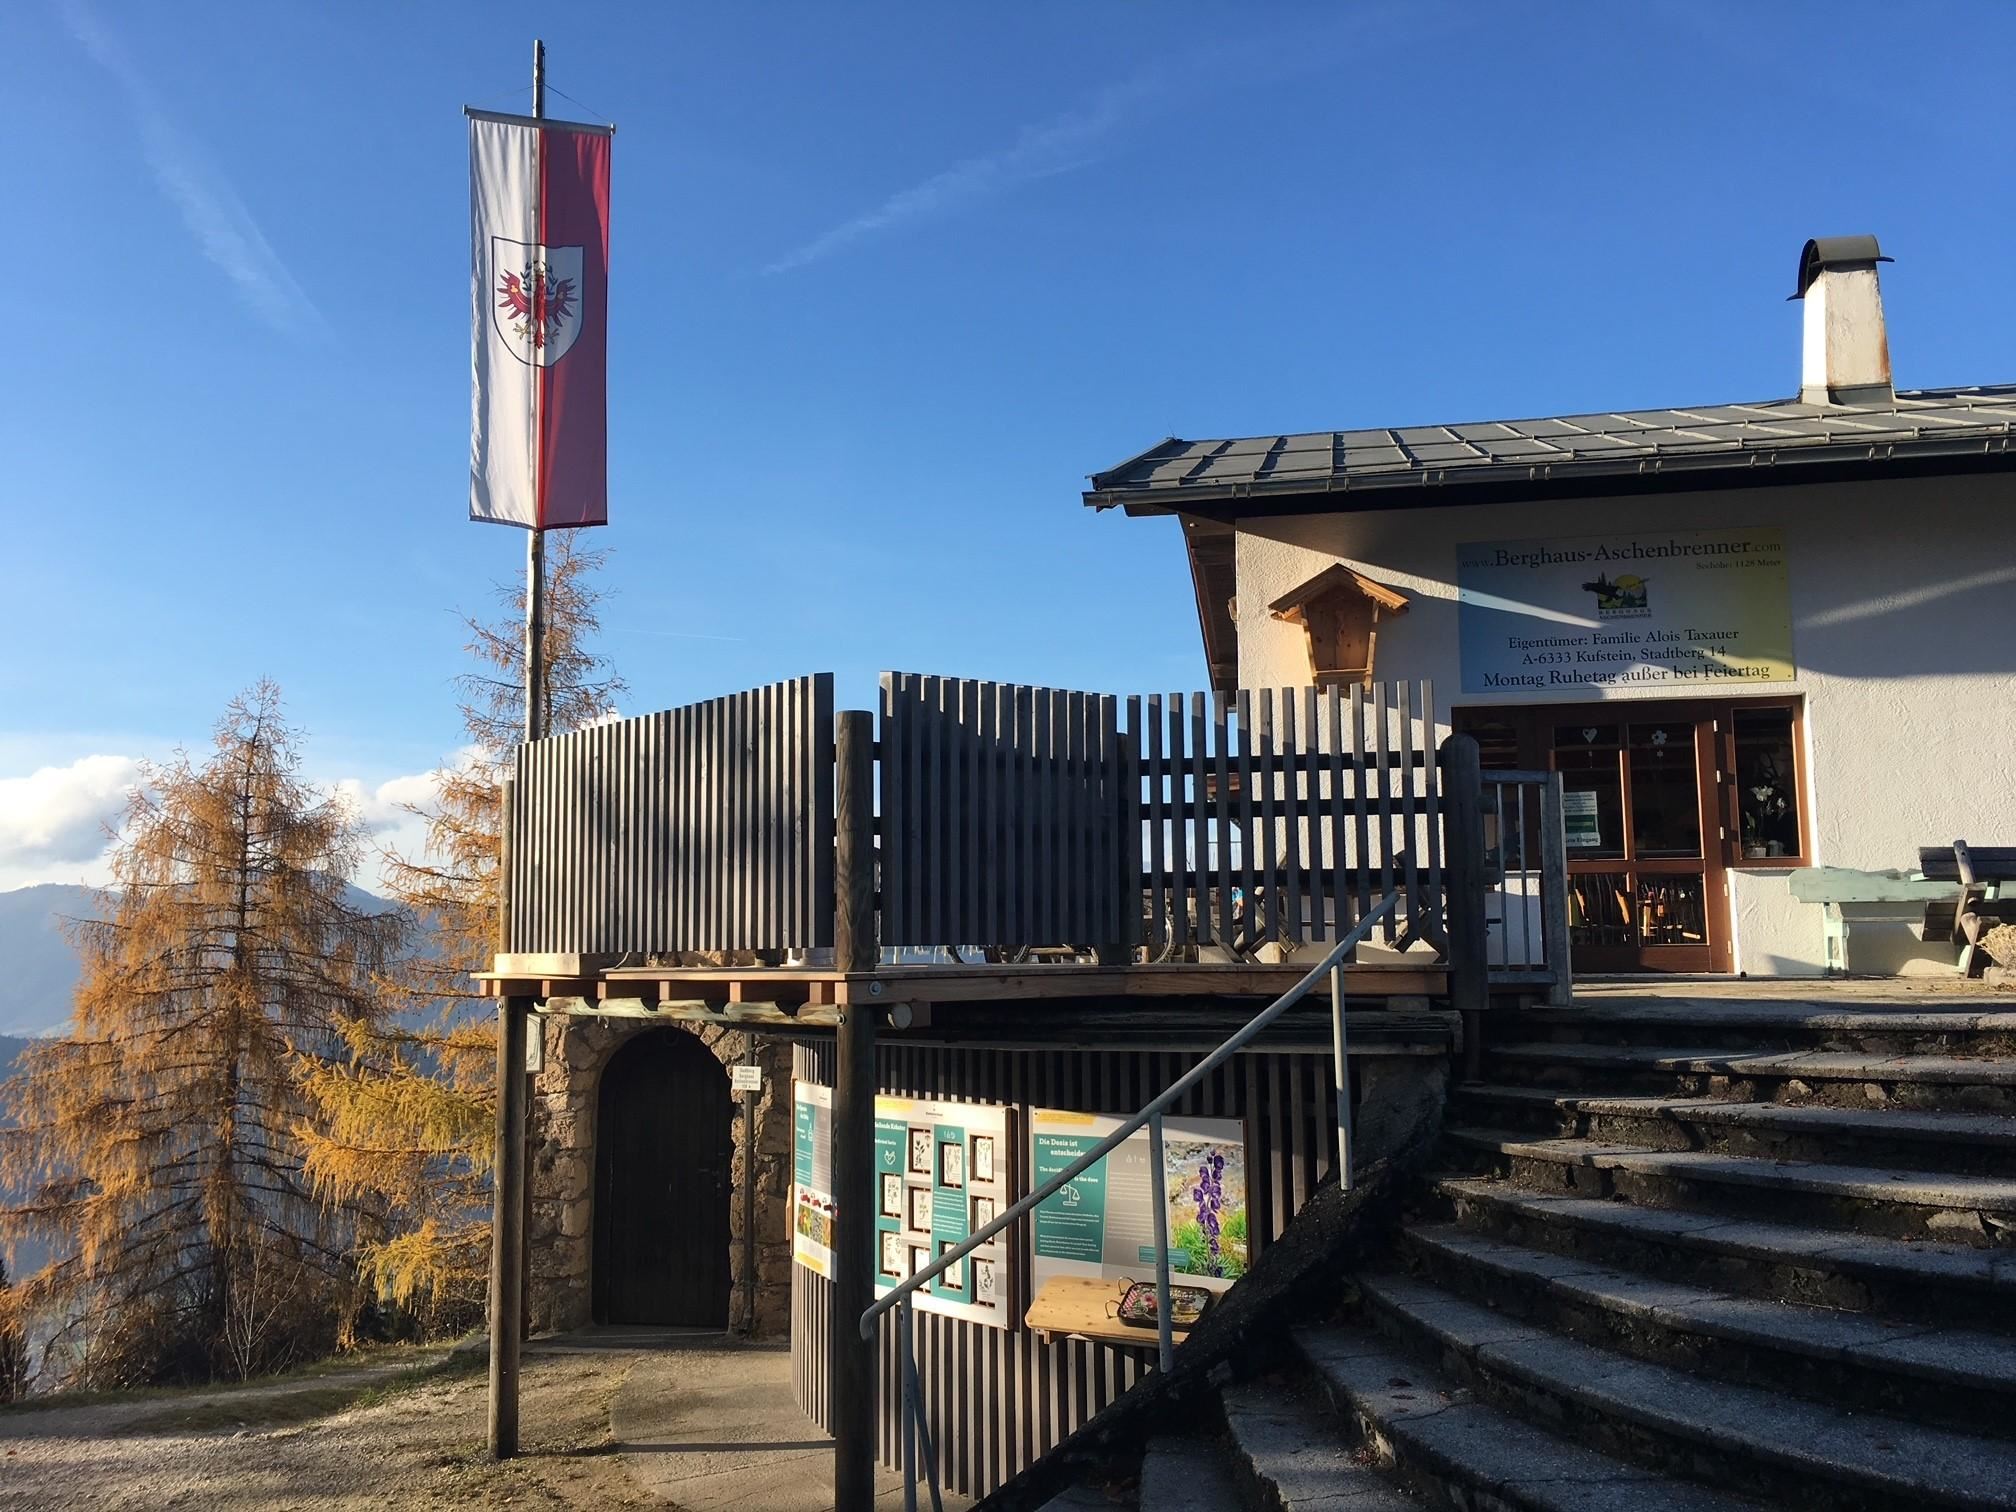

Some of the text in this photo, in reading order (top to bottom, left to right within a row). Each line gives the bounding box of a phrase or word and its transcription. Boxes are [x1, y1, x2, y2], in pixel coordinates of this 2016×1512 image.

[1757, 559, 1781, 567] Meter
[1508, 629, 1739, 650] Eigentümer: Familie Alois Taxauer
[1522, 645, 1727, 665] A-6333 Kufstein, Stadtberg 14
[1483, 663, 1770, 688] Montag Ruhetag außer bei Feiertag
[1039, 1137, 1050, 1146] Die
[1050, 1138, 1068, 1147] Dosis
